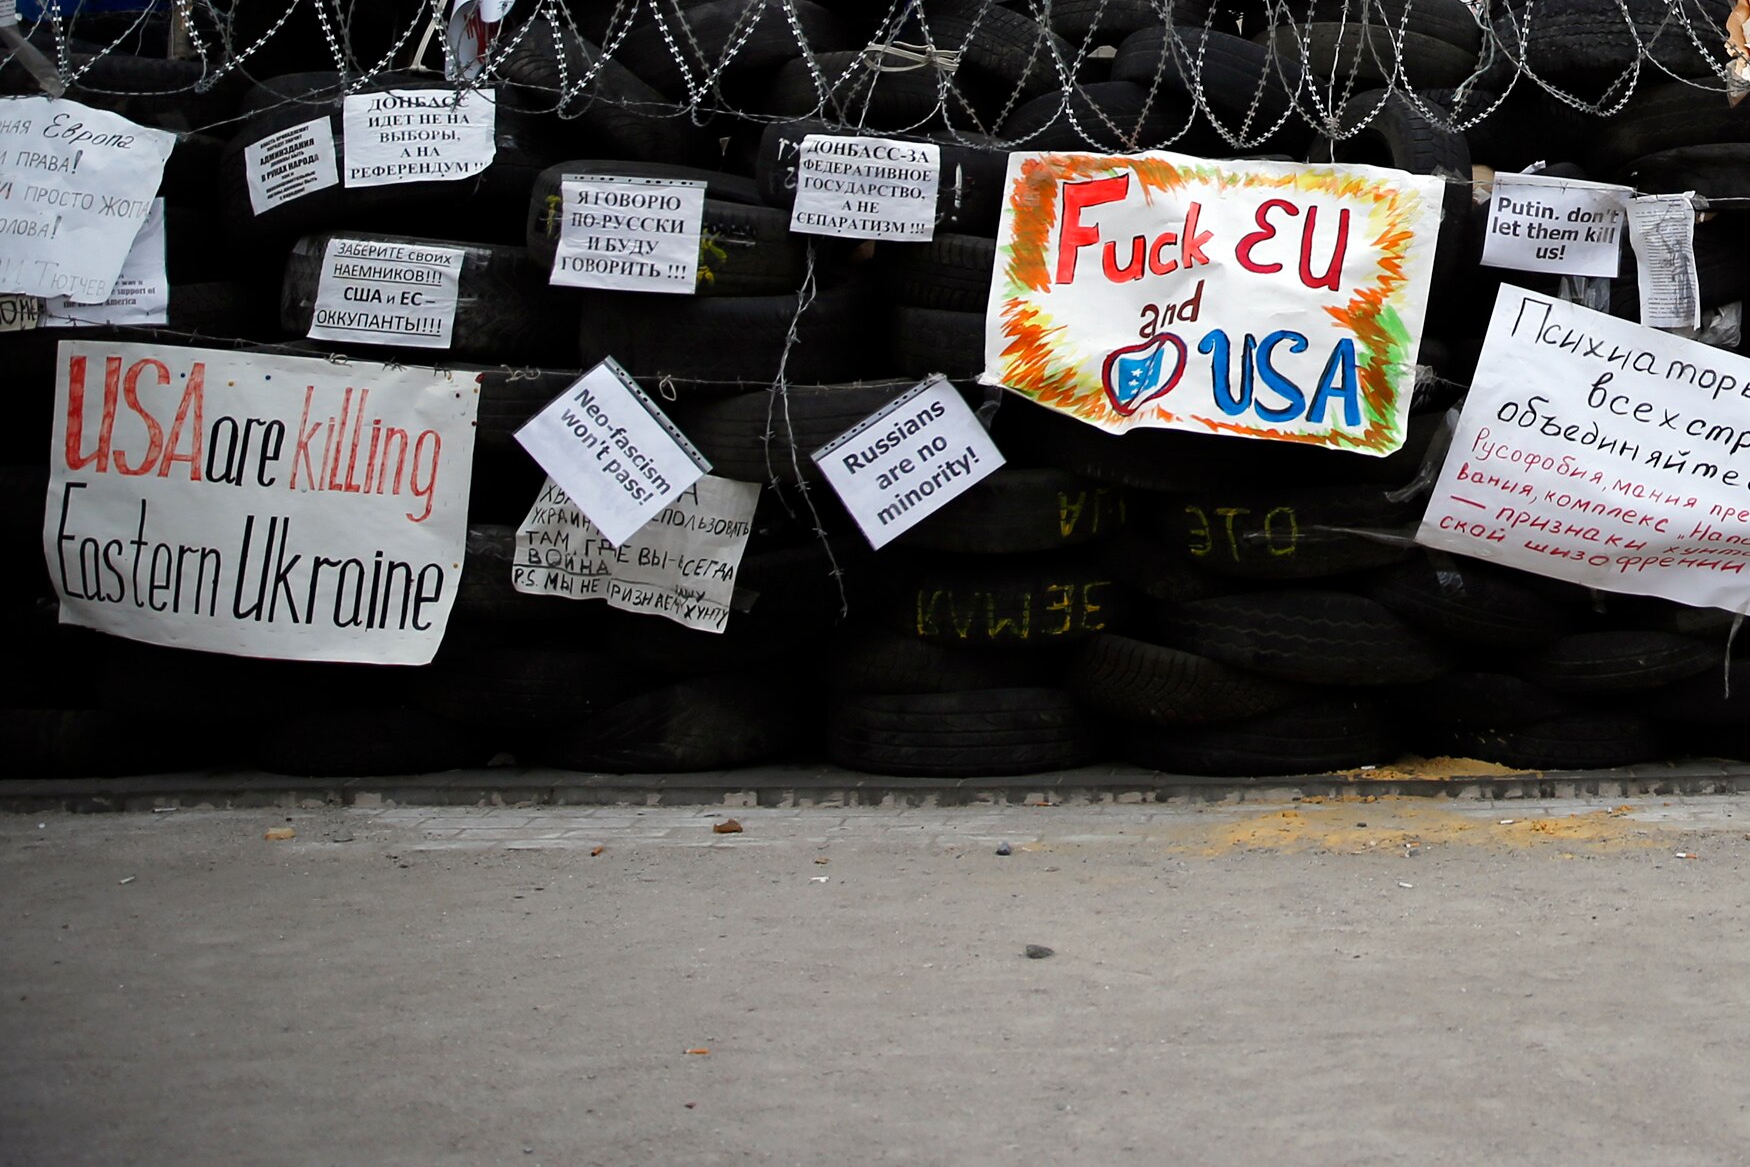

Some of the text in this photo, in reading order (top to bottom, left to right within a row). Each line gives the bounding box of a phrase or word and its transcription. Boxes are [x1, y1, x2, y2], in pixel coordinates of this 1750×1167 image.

[367, 95, 469, 113] ДОНБАСС
[42, 112, 136, 150] Европа
[368, 114, 470, 128] ИДЕТ НЕ НА
[380, 130, 461, 143] ВЫБОРЫ,
[15, 149, 84, 175] ПРАВА!
[260, 138, 314, 166] АДМИНЗДАНИЯ
[288, 154, 319, 170] НАРОДА
[400, 146, 440, 158] А НА
[807, 140, 930, 164] ДОНБАСС-ЗА
[350, 162, 469, 180] РЕФЕРЕНДУМ
[803, 159, 932, 182] ФЕДЕРАТИВНОЕ
[24, 185, 94, 210] ПРОСТО
[804, 177, 925, 200] ГОСУДАРСТВО,
[577, 190, 682, 212] Я ГОВОРЮ
[842, 201, 880, 213] А НЕ
[571, 213, 685, 235] ПО-РУССКИ
[796, 212, 905, 234] СЕПАРАТИЗМ
[1567, 207, 1619, 224] don't
[1055, 174, 1350, 291] Fuck EU
[1491, 217, 1616, 244] let them kill
[337, 242, 452, 264] ЗАБЕРИТЕ своих
[587, 236, 659, 255] И БУДУ
[1536, 245, 1566, 260] us!
[334, 263, 442, 284] НАЕМНИКОВ!!!
[561, 256, 661, 278] ГОВОРИТЬ
[344, 287, 423, 306] США и ЕС
[1139, 279, 1206, 339] and
[317, 310, 442, 333] ОККУПАНТЫ!!!
[1198, 328, 1361, 427] USA
[1587, 371, 1680, 429] всех
[63, 354, 442, 523] USA are killing
[573, 388, 672, 496] Neo-fascism
[842, 400, 946, 475] Russians
[560, 407, 655, 506] won't pass!
[875, 435, 948, 490] are no
[877, 446, 980, 526] minority!
[1612, 480, 1698, 510] мания
[1457, 463, 1670, 535] вания, комплекс
[1439, 513, 1506, 544] ской
[1495, 504, 1649, 553] признаки
[56, 481, 444, 634] Eastern Ukraine
[528, 549, 609, 574] ВОЙНА
[544, 573, 573, 592] МЫ
[581, 578, 600, 593] НЕ
